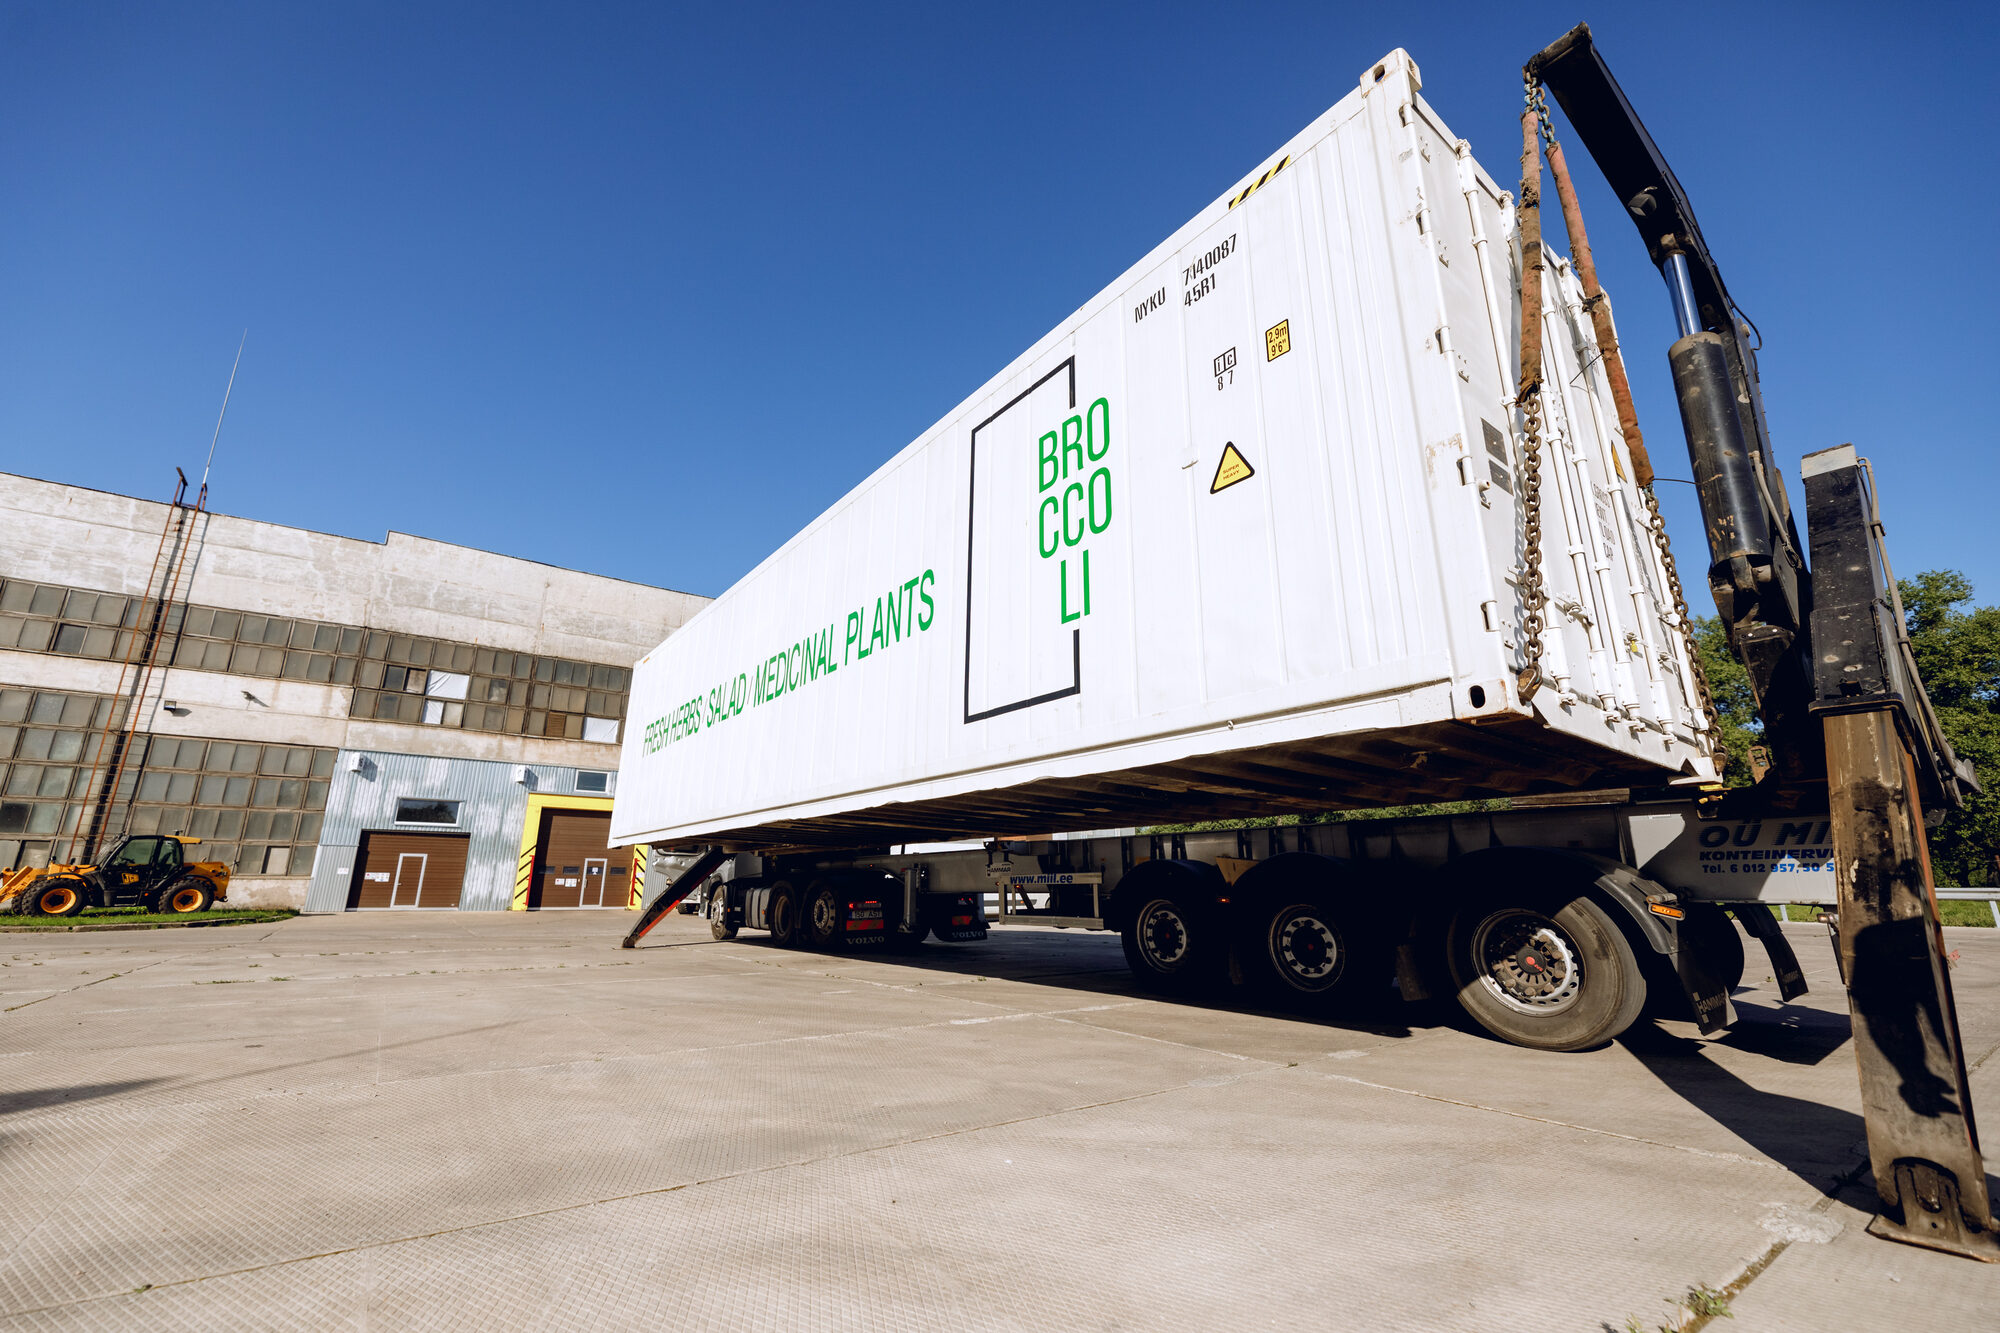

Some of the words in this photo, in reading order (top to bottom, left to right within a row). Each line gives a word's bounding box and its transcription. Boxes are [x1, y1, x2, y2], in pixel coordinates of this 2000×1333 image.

[1182, 232, 1237, 286] 7140087
[1134, 286, 1166, 323] NYKU
[1184, 272, 1216, 307] 45R1
[1038, 397, 1110, 493] BRO
[1038, 466, 1112, 559] CCO
[1060, 549, 1091, 625] LI
[641, 713, 672, 759] FRESH
[669, 694, 703, 744] HERBS
[706, 672, 747, 728] SALAD
[753, 623, 838, 708] MEDICINAL
[844, 568, 935, 666] PLANTS
[1699, 816, 1762, 848] OÜ
[1773, 820, 1833, 846] MI
[1010, 872, 1074, 884] www.miil.ee
[1702, 864, 1725, 874] Tel.
[1730, 863, 1738, 873] 6
[1743, 863, 1766, 873] 012
[1803, 862, 1820, 873] 50
[846, 935, 885, 945] VOLVO
[952, 930, 984, 939] VOLVO
